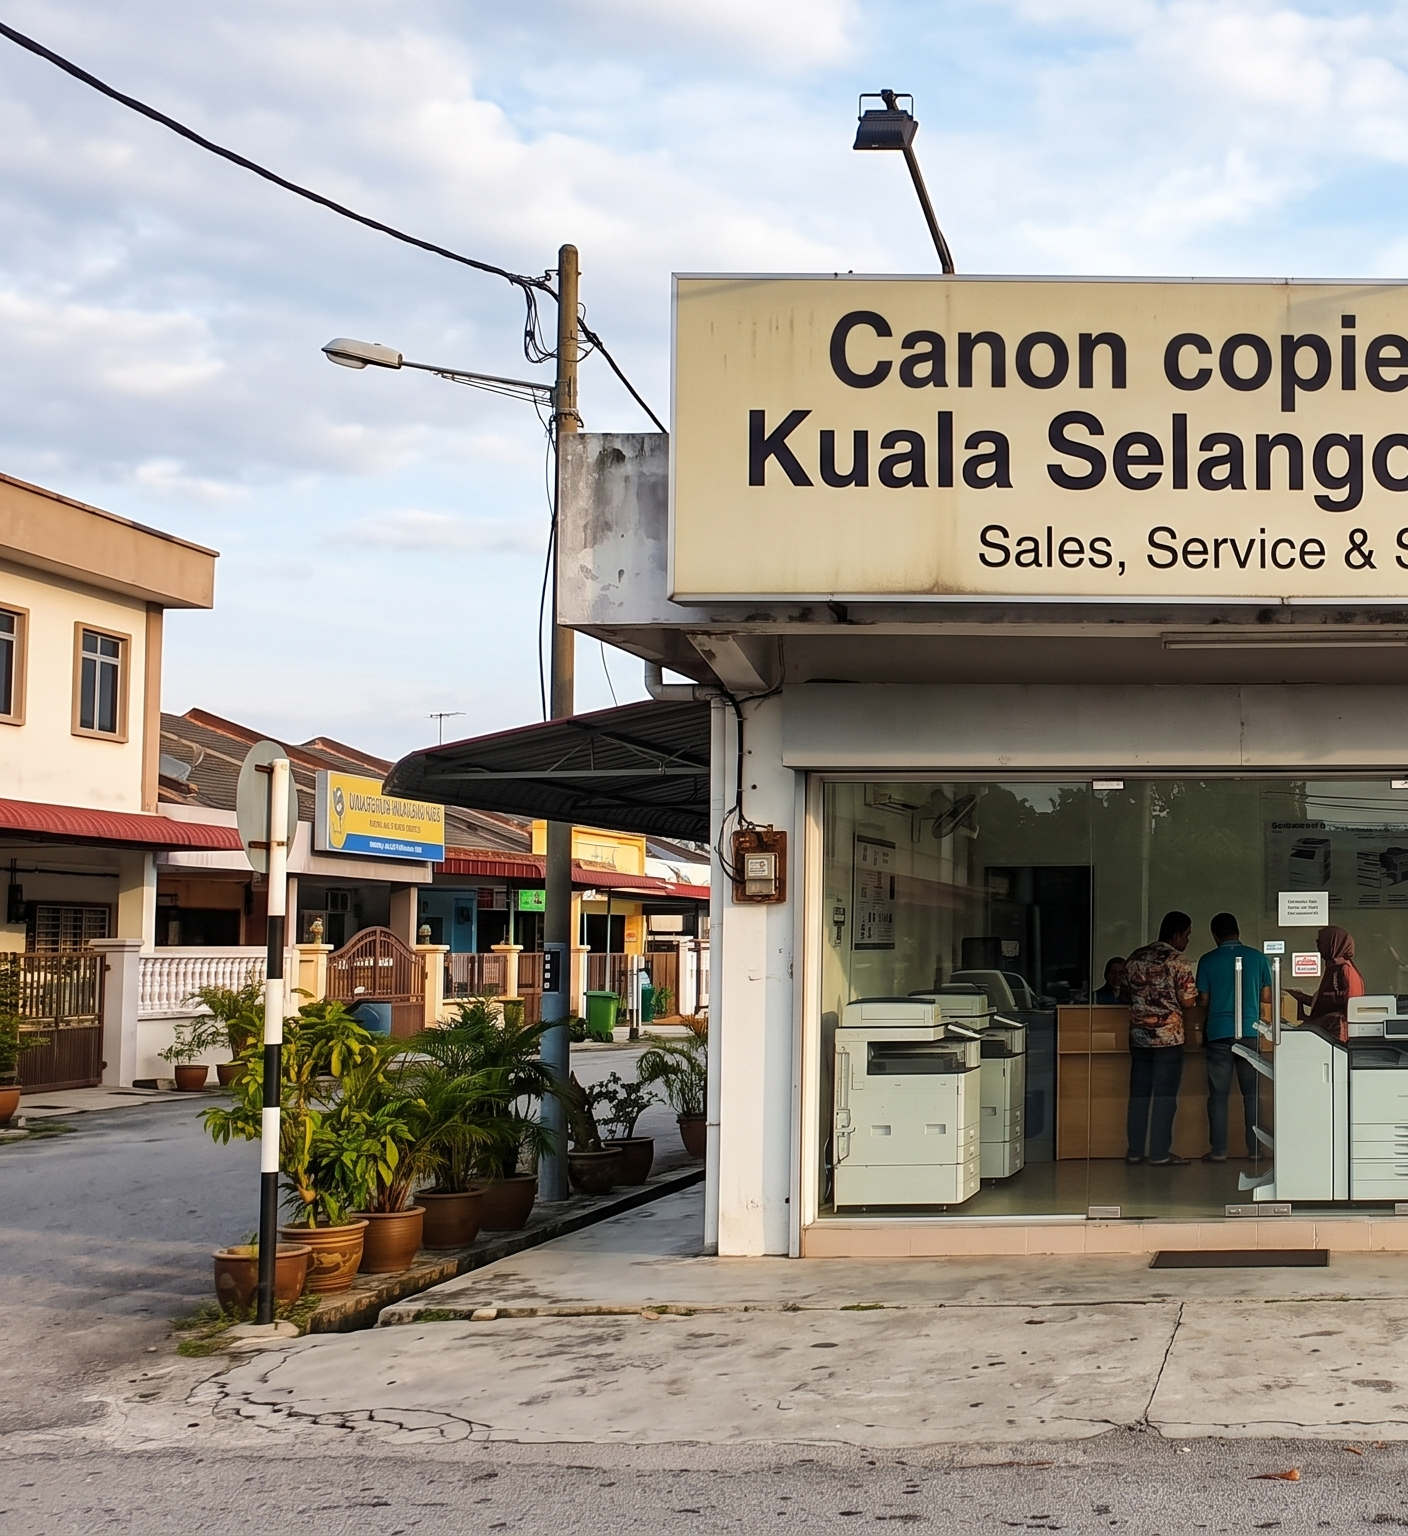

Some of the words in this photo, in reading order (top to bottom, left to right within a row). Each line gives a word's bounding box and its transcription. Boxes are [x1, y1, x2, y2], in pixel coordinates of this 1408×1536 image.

[829, 311, 1127, 390] Canon
[748, 410, 1014, 490] Kuala
[978, 525, 1127, 576] Sales,
[1146, 526, 1326, 571] Service
[1344, 528, 1378, 571] &
